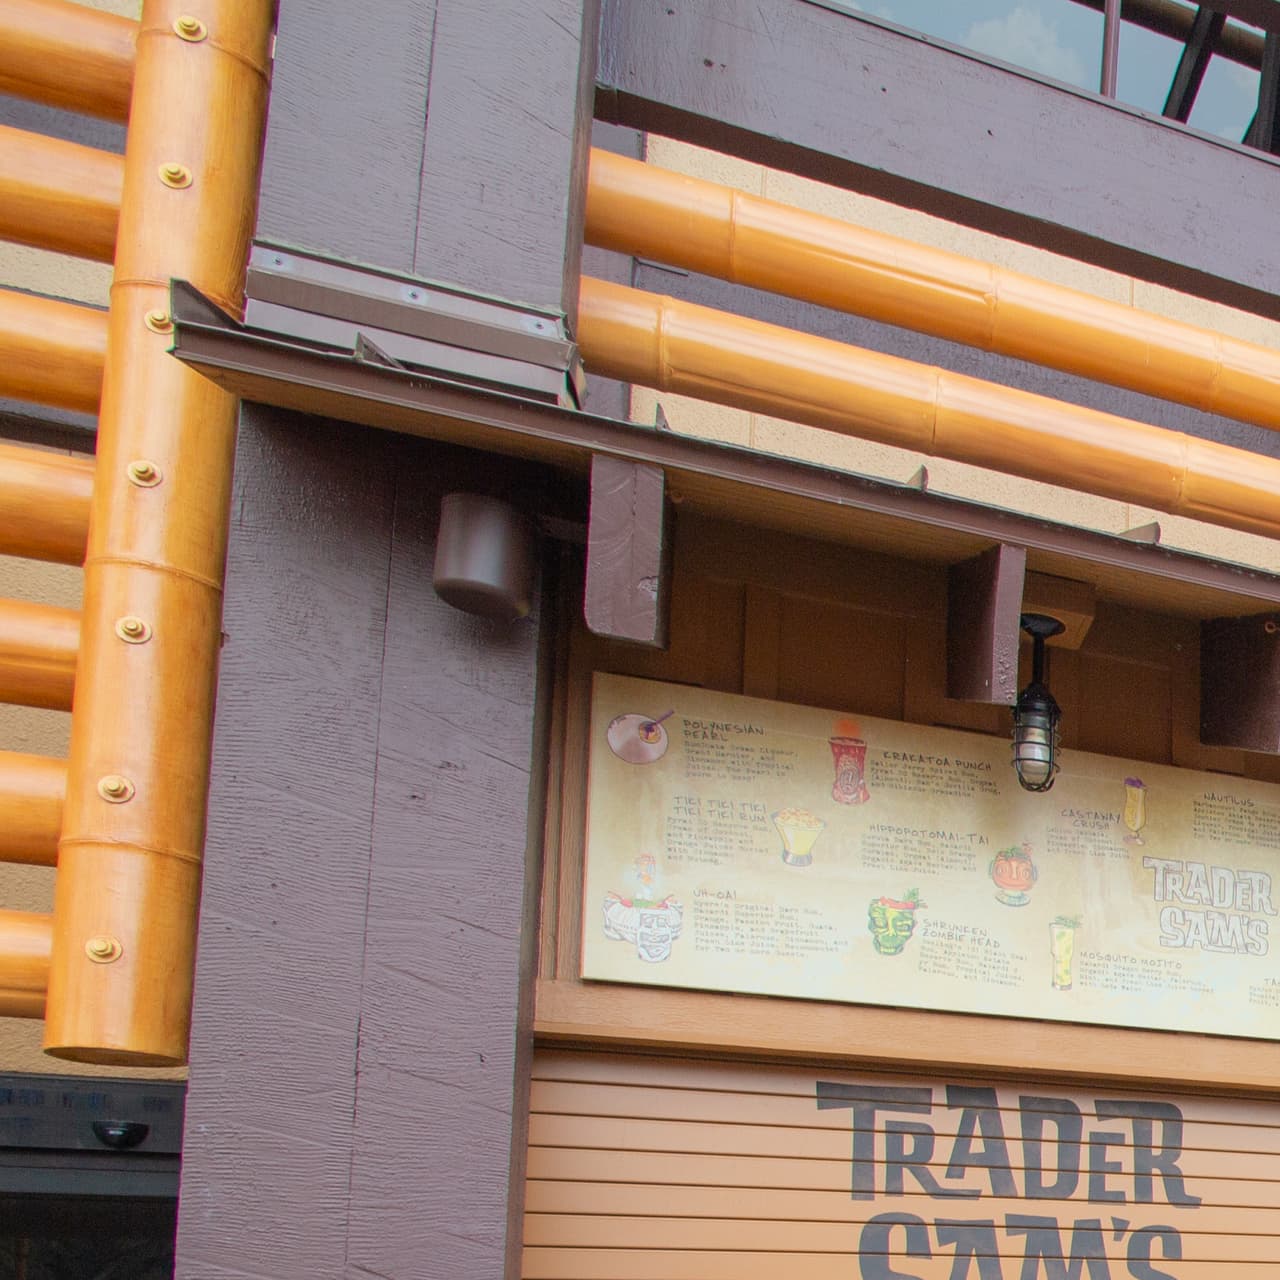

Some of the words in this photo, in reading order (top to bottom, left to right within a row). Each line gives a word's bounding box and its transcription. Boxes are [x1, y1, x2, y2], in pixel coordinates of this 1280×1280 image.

[683, 719, 765, 736] POLYNESIAN
[683, 730, 728, 741] PEARL
[883, 751, 951, 767] KRAKATOA
[955, 759, 992, 771] PUNCH
[673, 796, 701, 806] TIKI
[707, 799, 734, 808] TIKI
[740, 802, 766, 813] TIKI
[1203, 792, 1254, 807] NAUTILUS
[673, 806, 701, 816] TIKI
[707, 810, 733, 819] TIKI
[740, 813, 766, 824] RUM
[1061, 809, 1120, 824] CASTAWAY
[1072, 819, 1110, 830] CRUSH
[869, 823, 989, 845] HIPPOPOTOMAI-TAI
[1143, 855, 1279, 917] TRADER
[923, 918, 988, 936] SHRUNKEN
[1159, 905, 1269, 956] SAM'S
[922, 928, 965, 942] ZOMBIE
[970, 938, 1001, 949] HEAD
[1080, 951, 1137, 964] MOSQUITO
[1141, 959, 1183, 969] MOJITO
[816, 1081, 1202, 1209] TRADER
